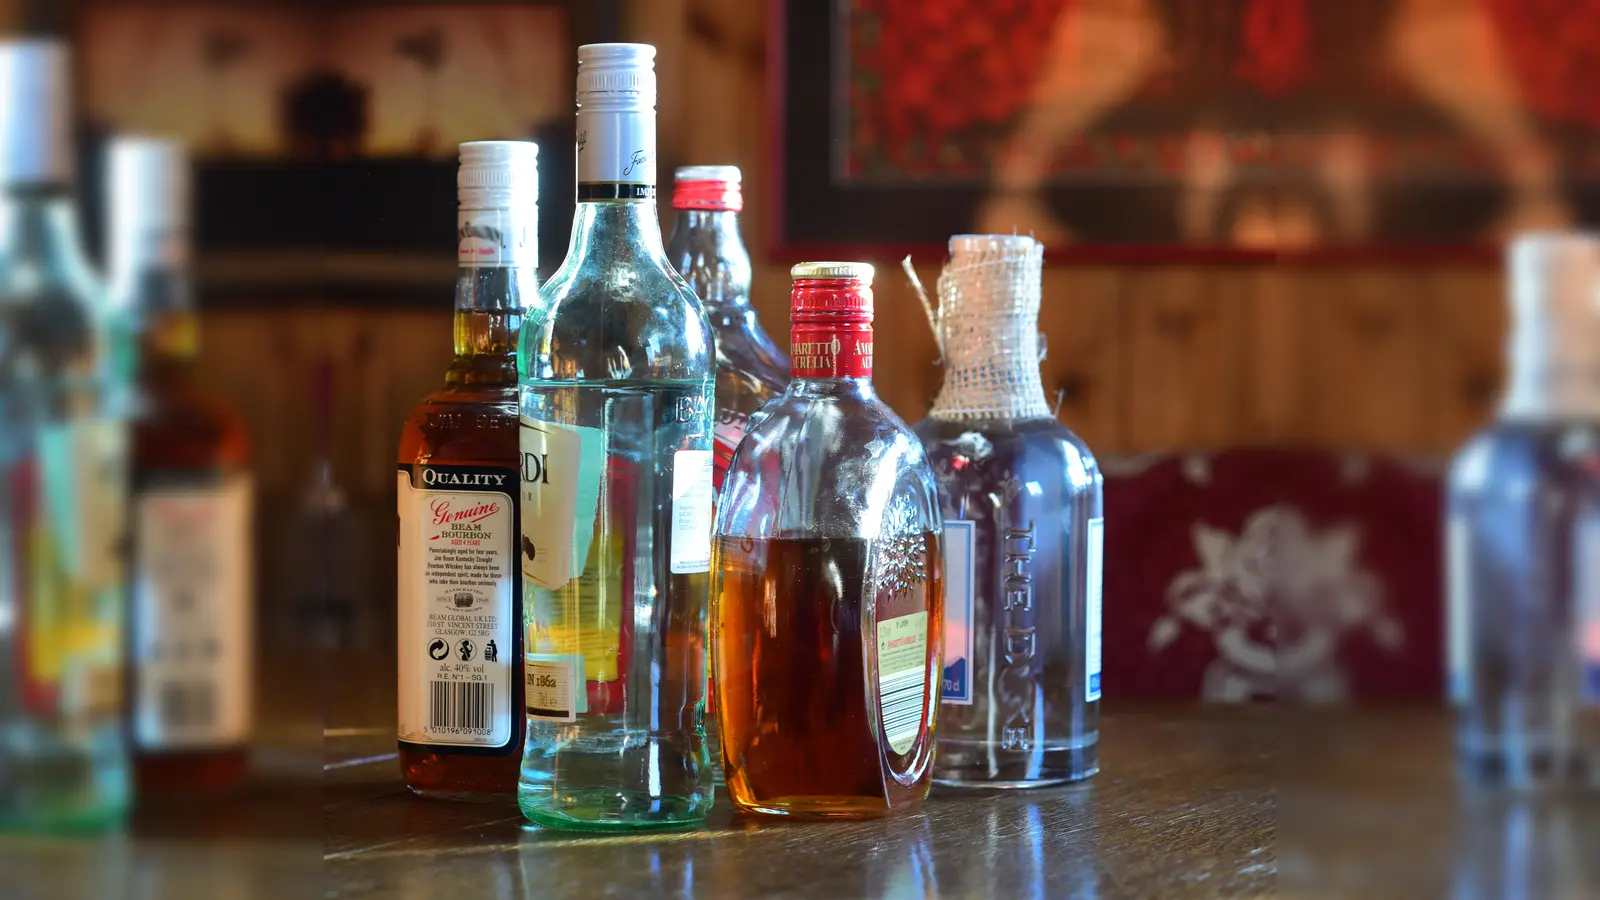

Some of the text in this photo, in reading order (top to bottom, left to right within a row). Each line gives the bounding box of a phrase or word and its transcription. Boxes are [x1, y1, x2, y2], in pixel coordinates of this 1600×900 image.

[422, 468, 507, 486] QUALITY
[430, 498, 500, 526] Genuine
[451, 523, 482, 532] BEAM
[441, 531, 492, 540] BOURBON
[1003, 520, 1036, 611] THE
[428, 613, 447, 622] BEAM
[448, 615, 473, 623] GLOBAL
[439, 663, 484, 673] alc. 40% vol
[536, 675, 557, 687] 1862
[432, 726, 460, 735] 010196
[463, 728, 491, 736] 091008
